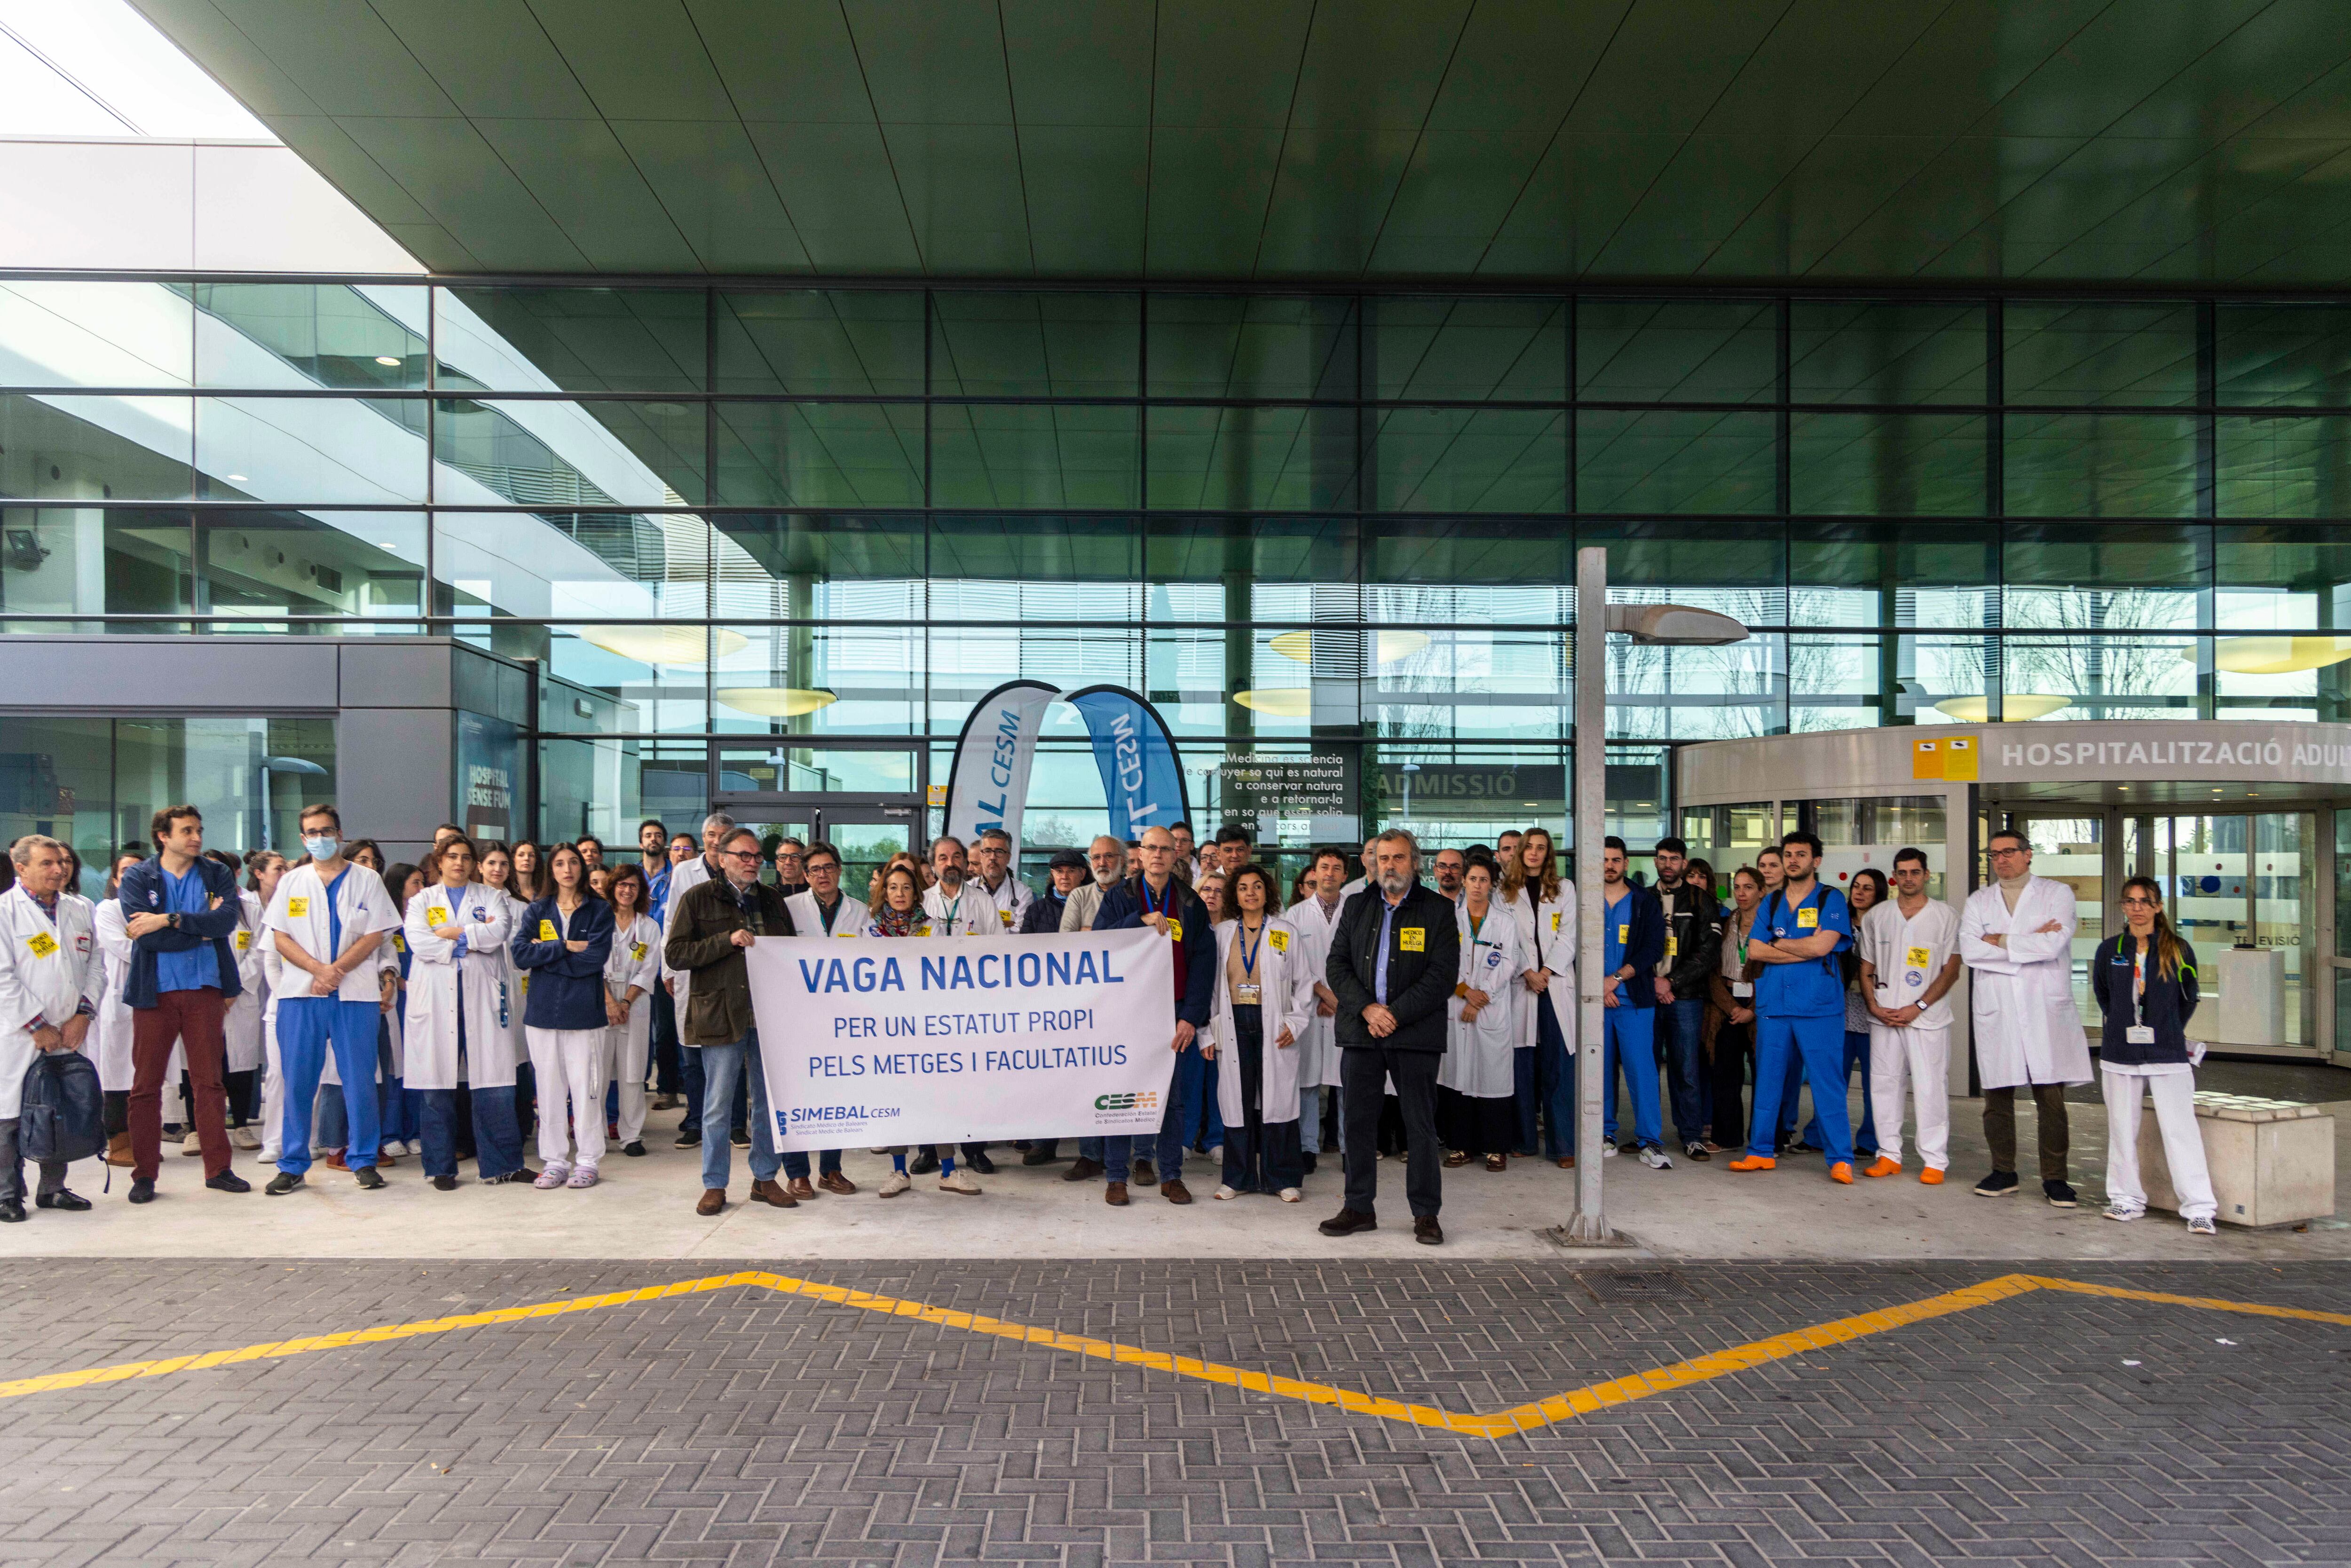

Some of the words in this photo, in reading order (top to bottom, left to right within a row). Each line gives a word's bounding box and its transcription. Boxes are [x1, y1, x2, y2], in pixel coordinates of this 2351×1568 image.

[992, 709, 1020, 788] CESM
[2003, 738, 2281, 765] HOSPITALITZACIÓ
[2291, 744, 2351, 767] ADUL
[1299, 753, 1343, 764] sciencia
[469, 764, 509, 788] HOSPITAL
[1266, 766, 1283, 779] qui
[1303, 766, 1343, 777] natural
[1306, 781, 1343, 791] natura
[1283, 793, 1343, 804] retornar-la
[1284, 809, 1313, 817] esser
[1317, 806, 1343, 817] solia
[799, 957, 905, 993] VAGA
[921, 950, 1124, 990] NACIONAL
[835, 1017, 877, 1038] PER
[885, 1016, 915, 1037] UN
[925, 1012, 1020, 1036] ESTATUT
[1029, 1009, 1093, 1032] PROPI
[809, 1055, 865, 1077] PELS
[874, 1052, 963, 1075] METGES
[972, 1052, 977, 1072] I
[986, 1045, 1127, 1072] FACULTATIUS
[1095, 1091, 1157, 1110] CESM
[790, 1106, 869, 1122] SIMEBAL
[871, 1108, 900, 1118] CESM
